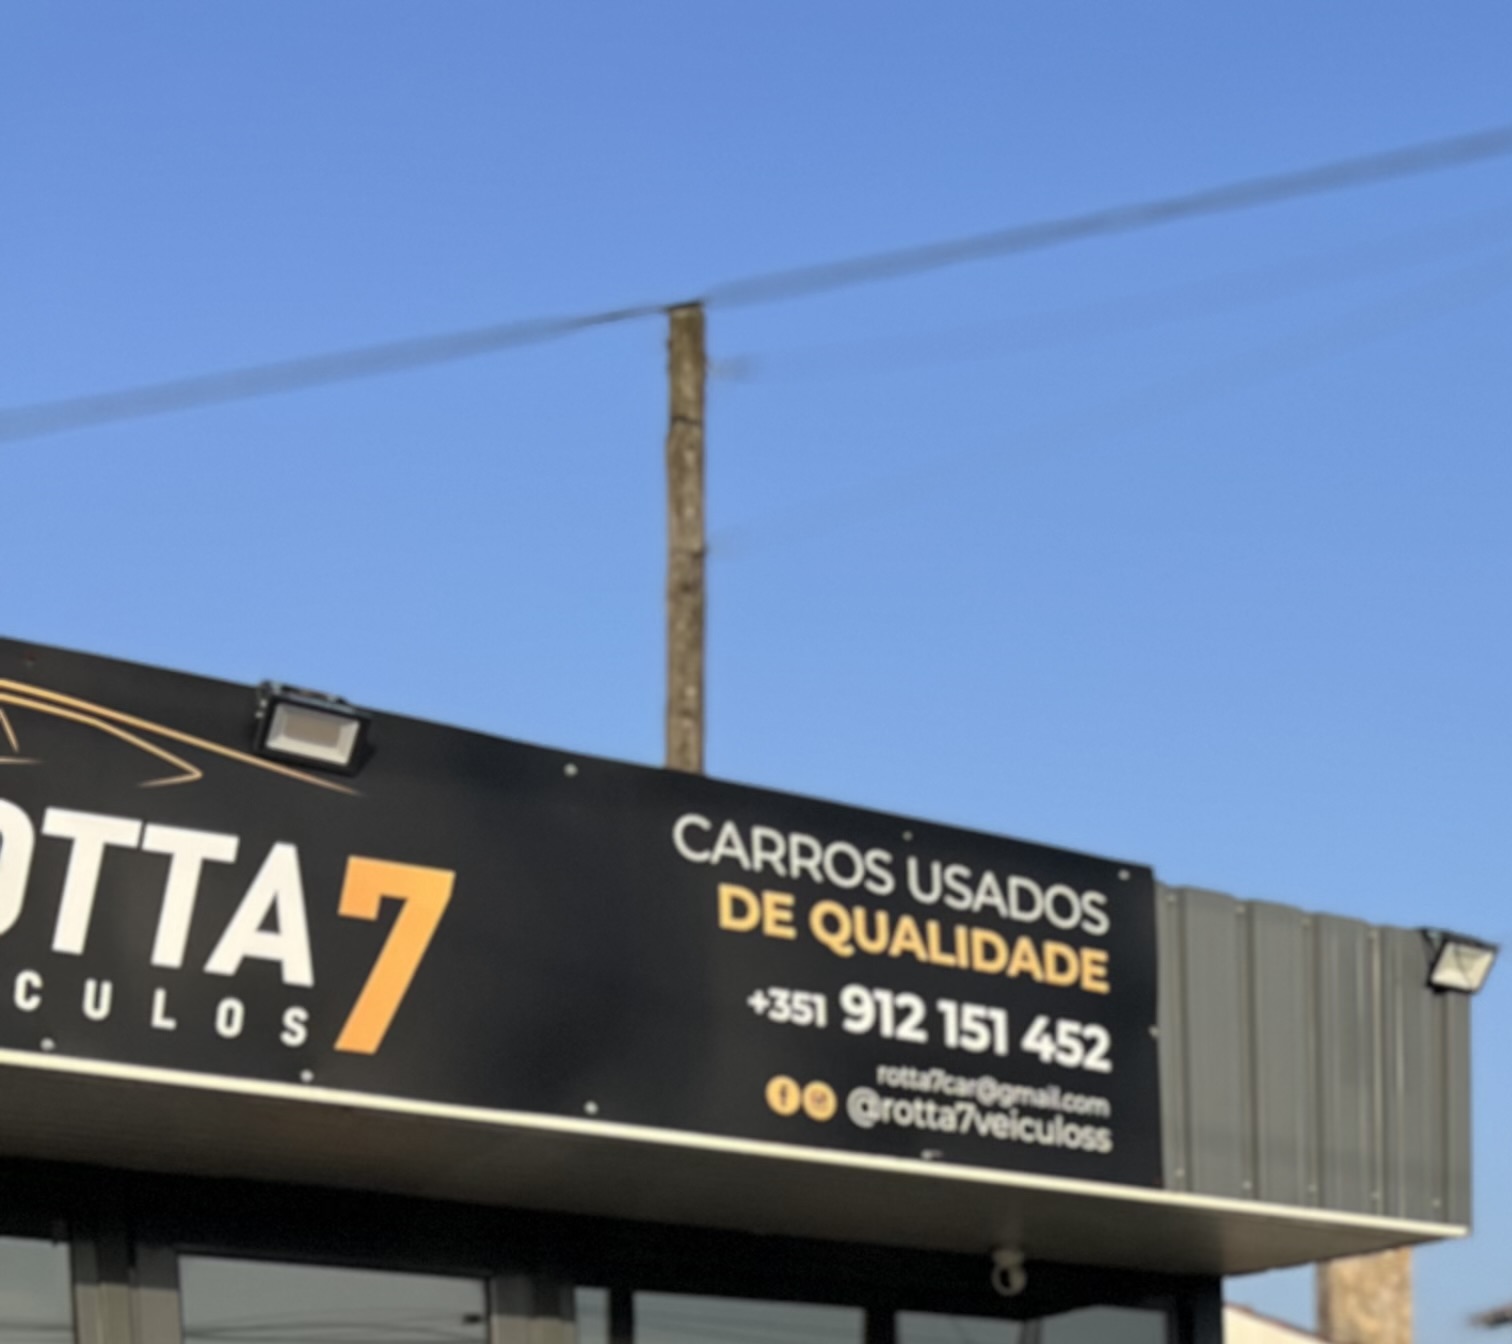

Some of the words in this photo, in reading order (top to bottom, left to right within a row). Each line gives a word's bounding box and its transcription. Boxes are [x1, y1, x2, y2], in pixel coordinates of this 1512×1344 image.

[672, 813, 895, 896] CARROS
[906, 855, 1110, 936] USADOS
[718, 883, 797, 940] DE
[809, 900, 1110, 994] QUALIDADE
[747, 985, 828, 1029] +351
[839, 983, 928, 1044] 912
[936, 999, 1009, 1056] 151
[1021, 1014, 1112, 1073] 452
[847, 1086, 1113, 1154] @rotta7veiculoss
[876, 1064, 1111, 1118] rotta7car@gmail.com
